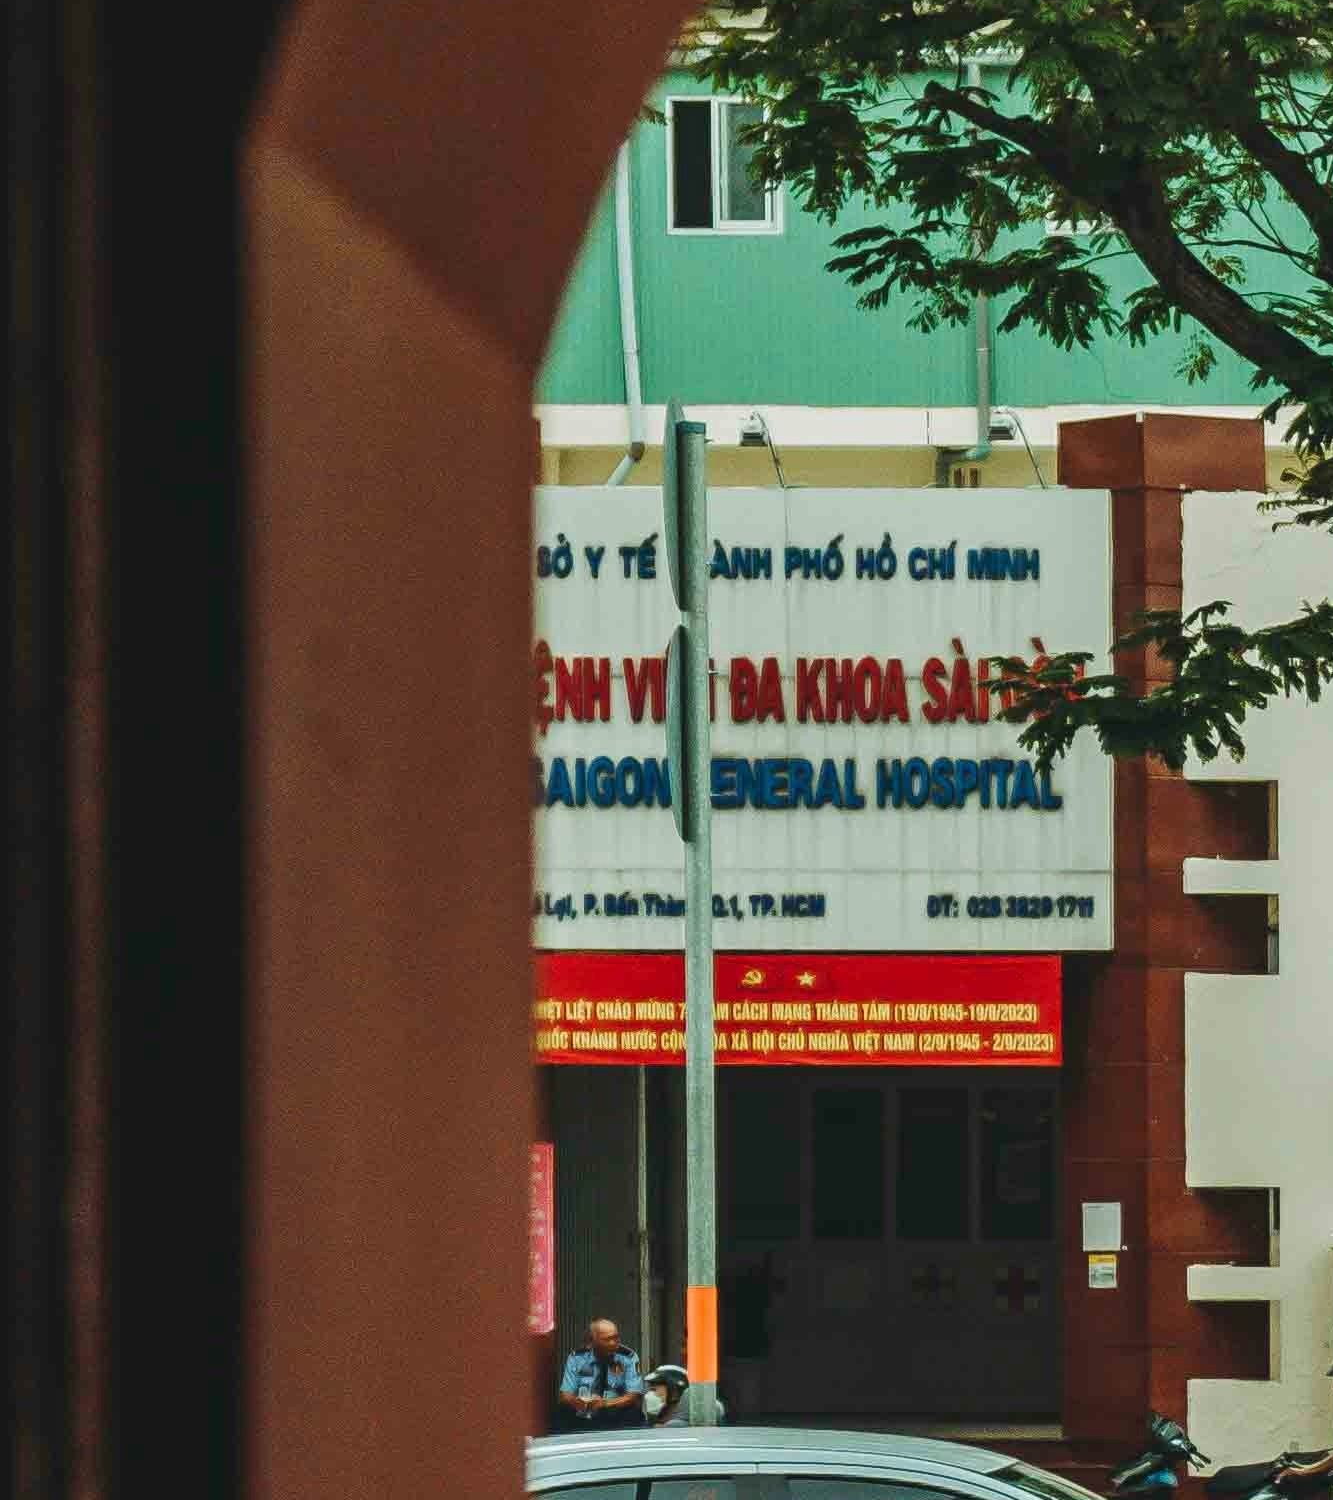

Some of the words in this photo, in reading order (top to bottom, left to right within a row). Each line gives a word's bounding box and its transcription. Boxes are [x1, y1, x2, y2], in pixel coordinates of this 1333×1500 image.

[584, 546, 605, 579] Y
[709, 539, 773, 580] ÀNH
[908, 540, 957, 581] CHÍ
[967, 547, 1041, 581] MINH
[534, 640, 611, 736] ỆNH
[729, 656, 786, 724] ĐA
[796, 655, 911, 724] KHOA
[920, 636, 990, 724] SÀI
[709, 757, 866, 810] ENERAL
[876, 756, 1064, 811] HOSPITAL
[732, 999, 768, 1021] CÁCH
[771, 1002, 811, 1025] MẠNG
[815, 999, 858, 1021] THÁNG
[861, 999, 891, 1021] TÁM
[572, 1029, 617, 1050] KHÁNH
[852, 1029, 881, 1055] VIỆT
[884, 1033, 915, 1051] NAM
